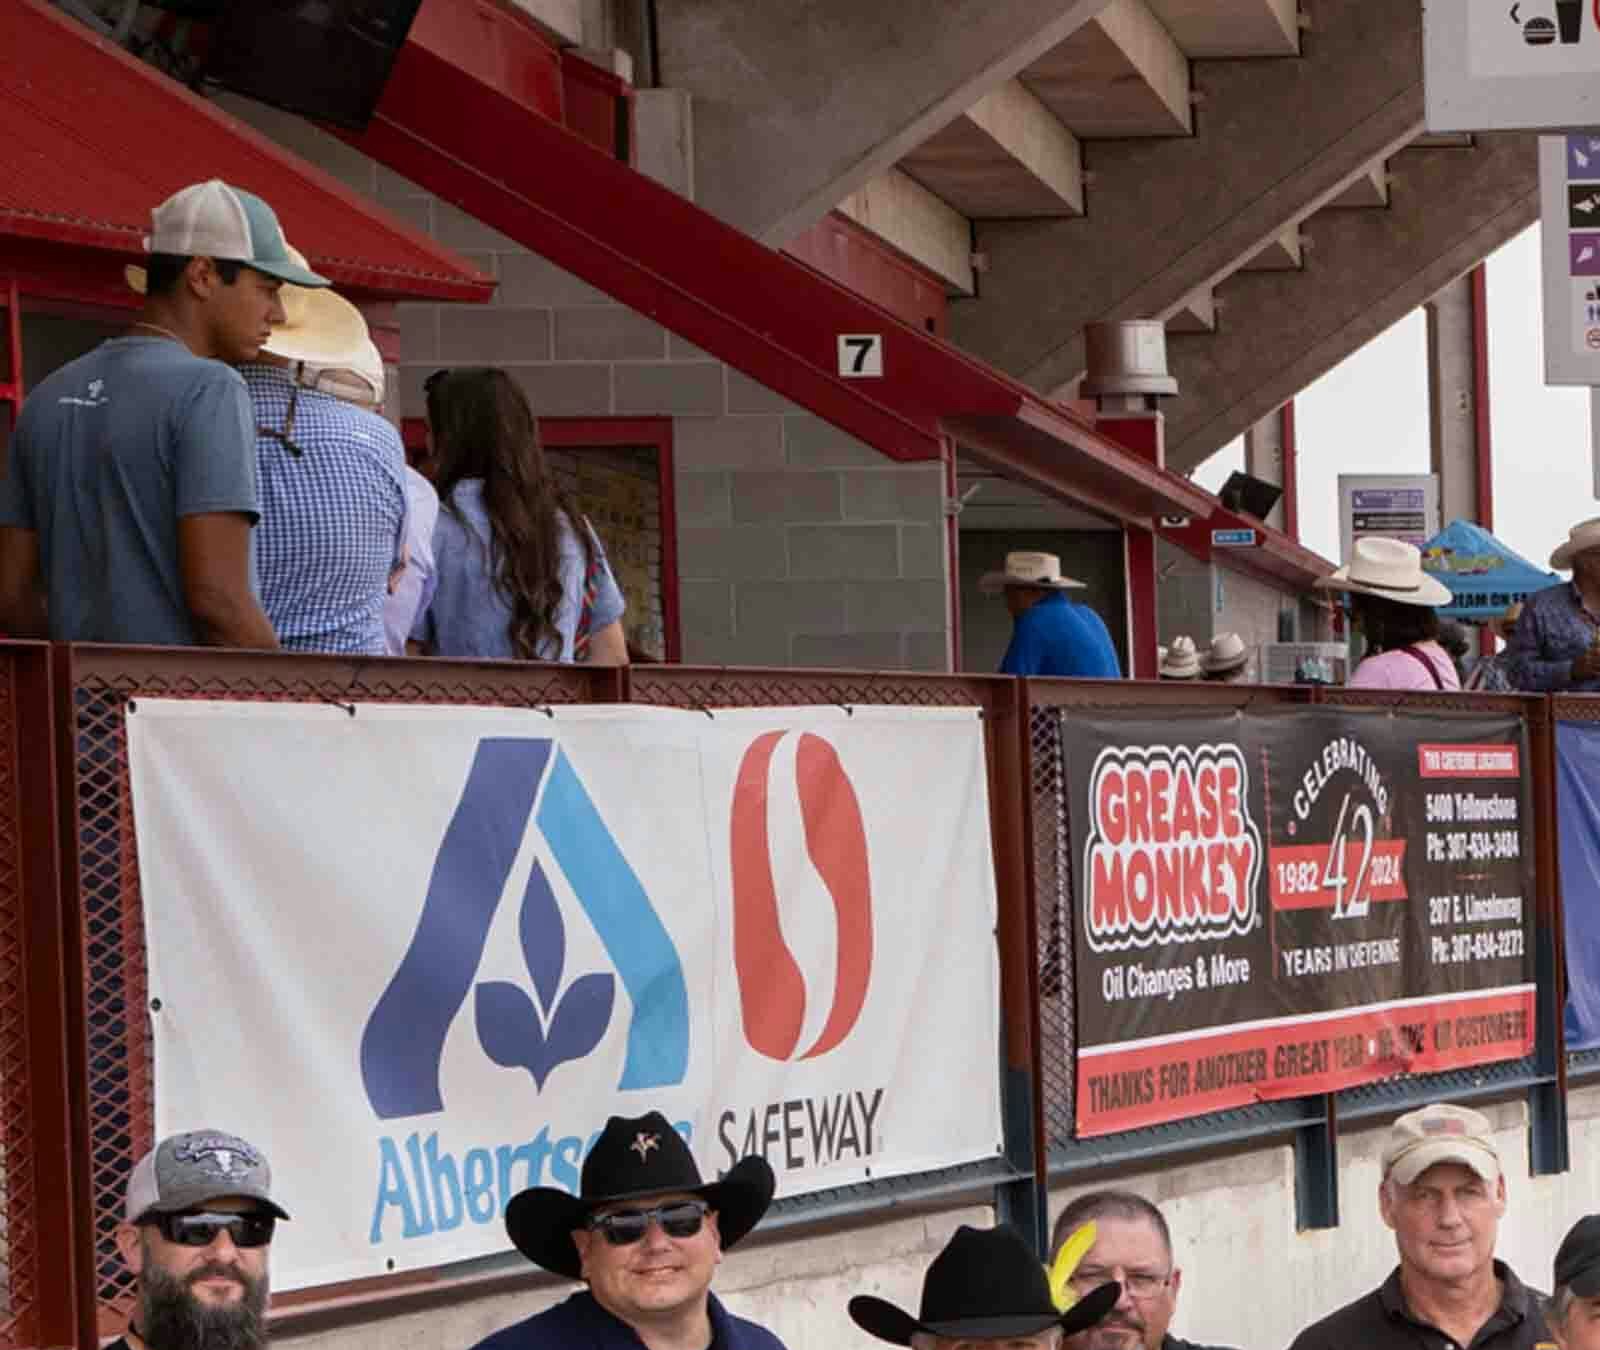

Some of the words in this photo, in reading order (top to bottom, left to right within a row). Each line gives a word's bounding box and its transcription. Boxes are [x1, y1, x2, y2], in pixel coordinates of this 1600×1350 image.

[845, 338, 873, 371] 7
[1098, 760, 1245, 847] GREASE
[1294, 737, 1388, 819] CELEBRATING
[1091, 843, 1254, 934] MONKEY
[1277, 861, 1320, 893] 1982
[1370, 855, 1400, 886] 2024
[1322, 792, 1374, 921] 42
[1103, 965, 1124, 1000] Oil
[1127, 963, 1193, 1000] Changes
[1197, 955, 1208, 988] &
[1212, 953, 1250, 986] More
[1282, 946, 1332, 977] YEARS
[1335, 945, 1349, 971] IN
[1088, 1067, 1153, 1113] THANKS
[1158, 1066, 1190, 1098] FOR
[1193, 1048, 1267, 1094] ANOTHER
[1273, 1041, 1331, 1076] GREAT
[1334, 1034, 1364, 1067] YEAR
[718, 1088, 883, 1178] SAFEWAY
[369, 1119, 693, 1244] Alberts
